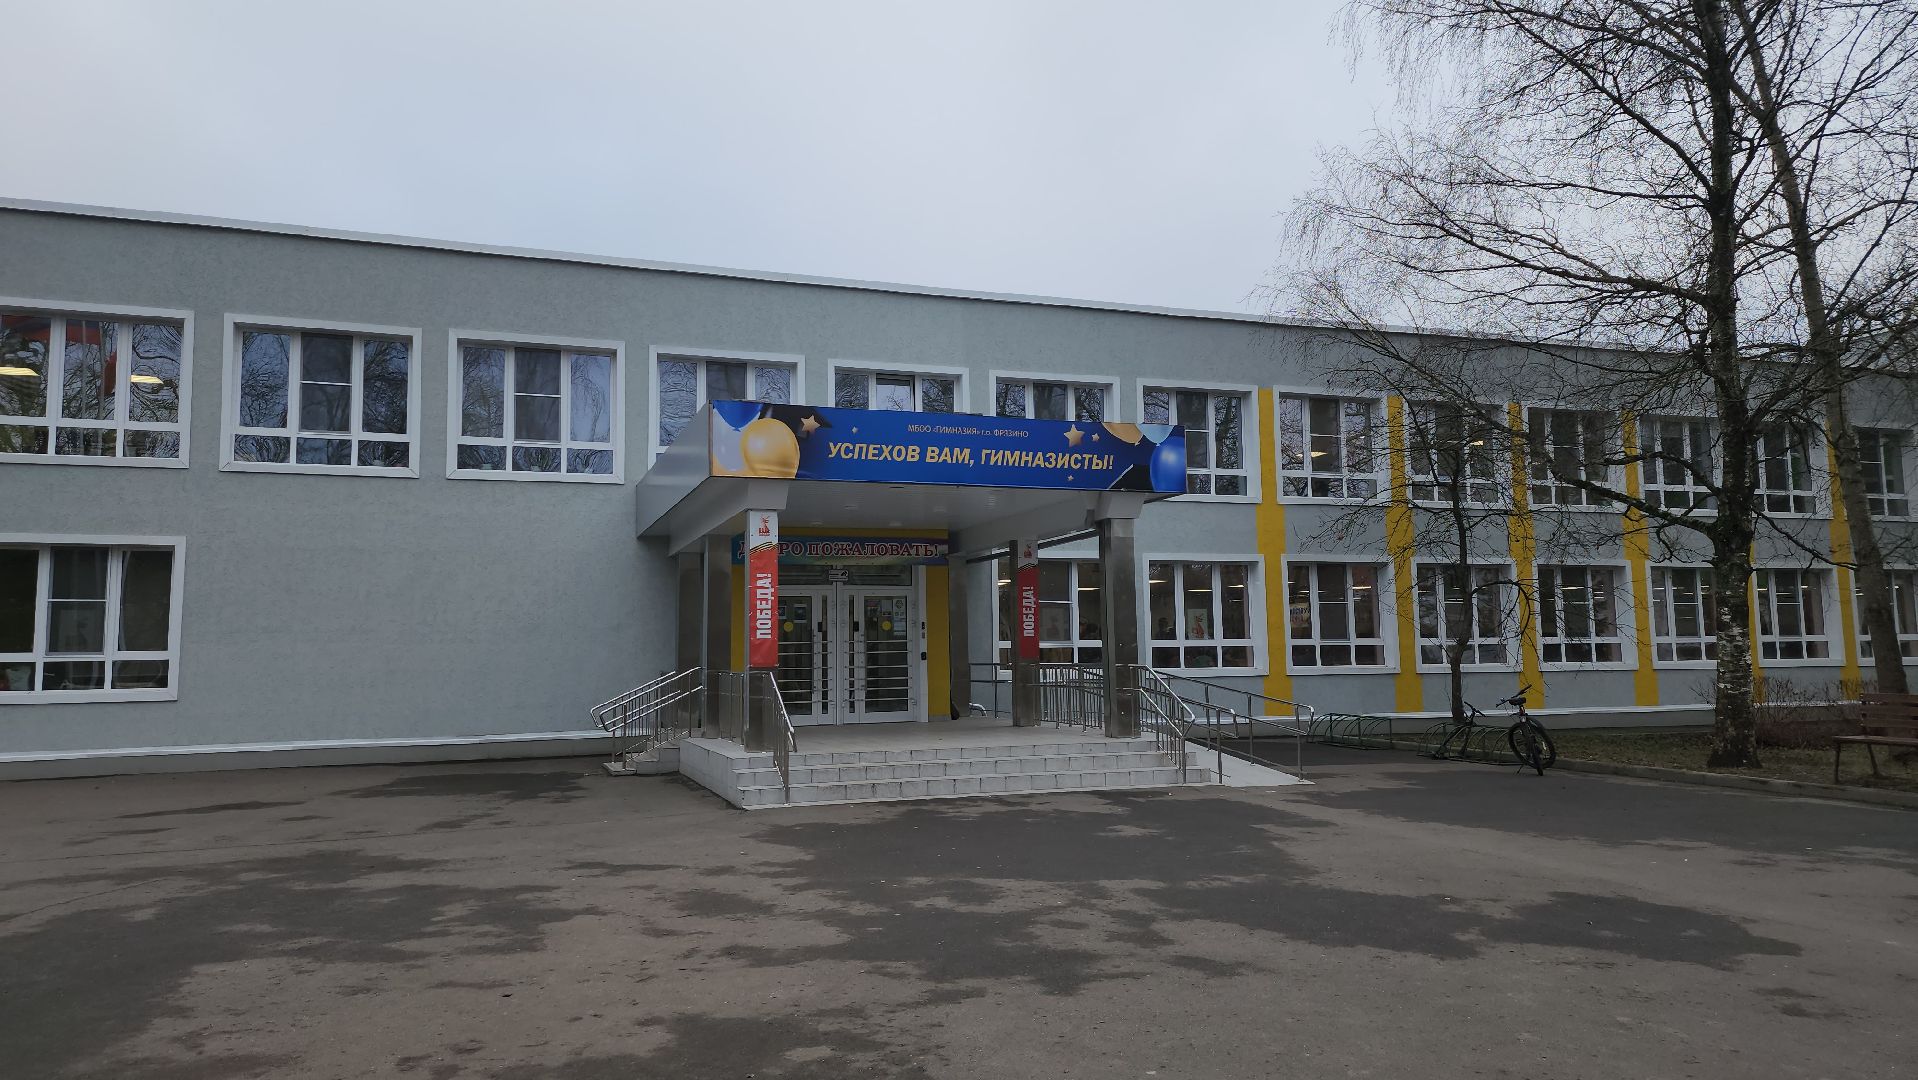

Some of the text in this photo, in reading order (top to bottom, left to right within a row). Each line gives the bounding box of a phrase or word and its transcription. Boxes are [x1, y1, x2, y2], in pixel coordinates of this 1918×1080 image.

[933, 425, 980, 435] «ГИМНАЗИЯ»
[993, 428, 1029, 438] ФРЯЗИНО
[828, 442, 1114, 470] УСПЕХОВ ВАМ, ГИМНАЗИСТЫ!
[807, 541, 940, 558] ПОЖАЛОВАТЬ!
[756, 573, 775, 639] ПОБЕДА!
[1022, 587, 1036, 637] ПОБЕДА!
